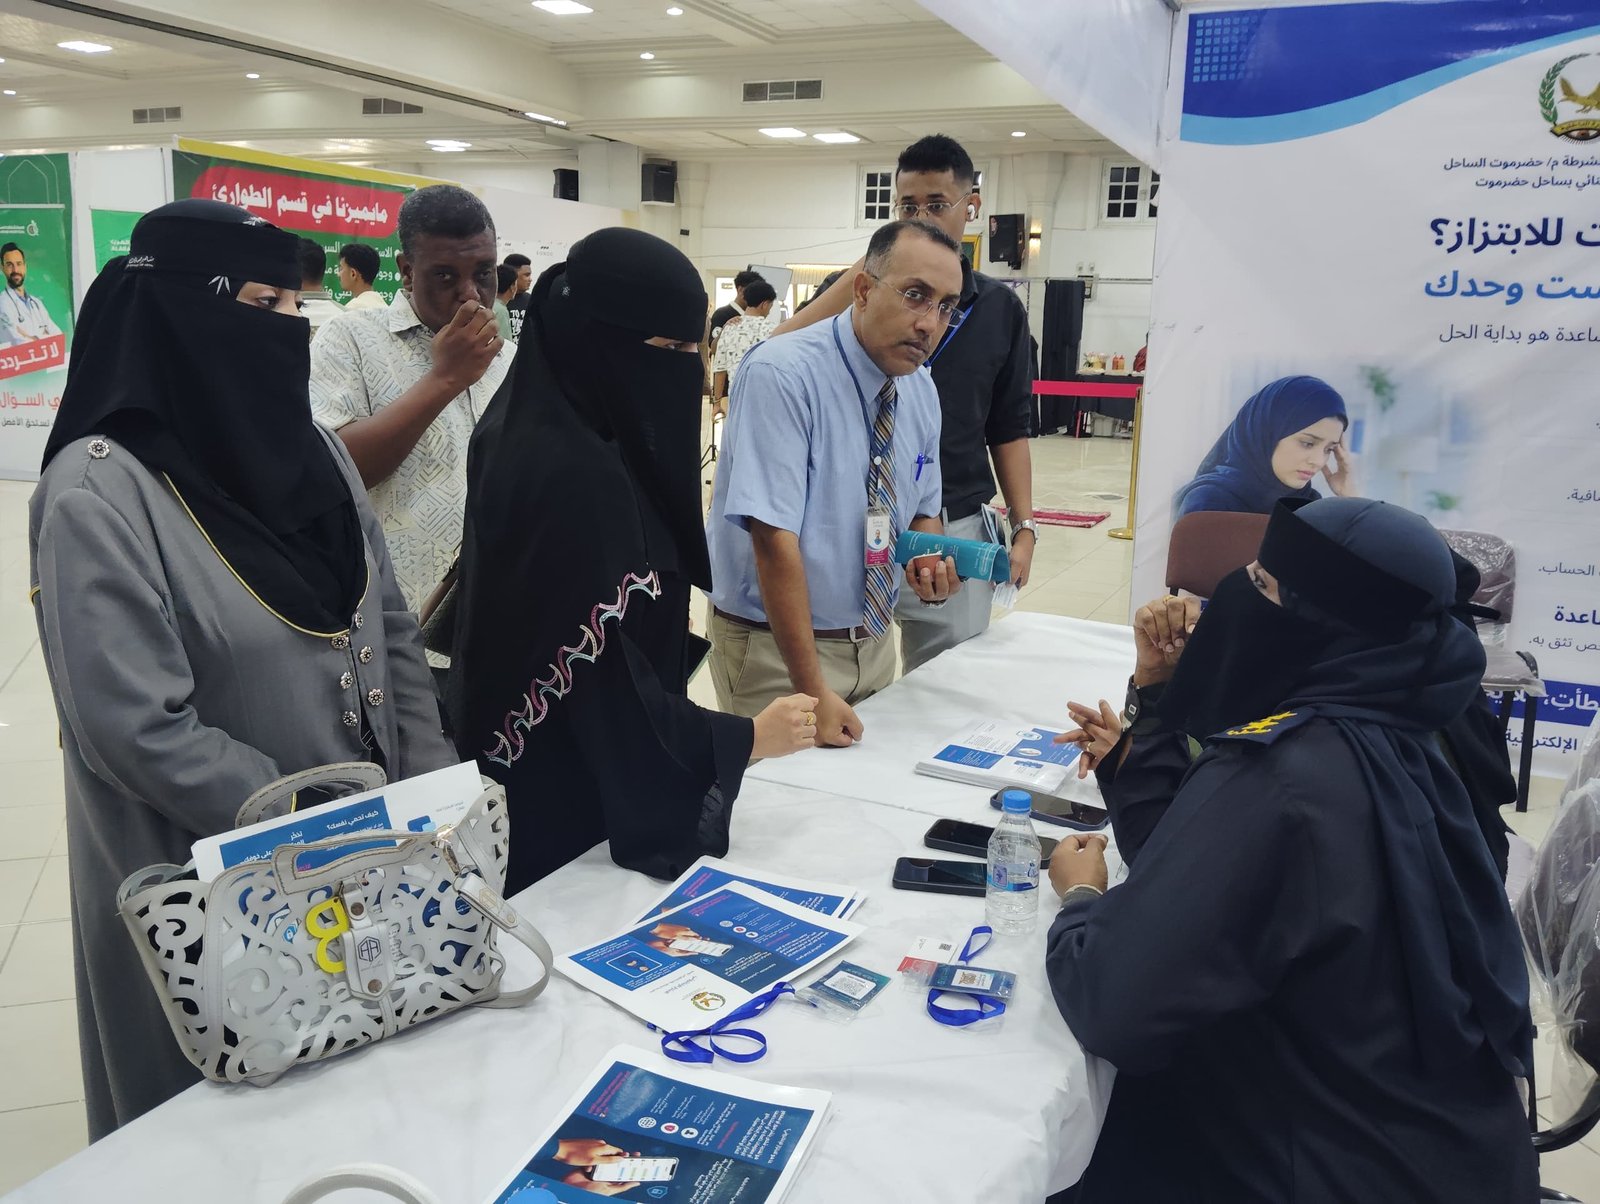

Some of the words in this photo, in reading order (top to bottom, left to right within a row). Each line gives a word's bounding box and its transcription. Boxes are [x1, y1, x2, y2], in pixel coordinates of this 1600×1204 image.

[1443, 157, 1487, 171] الساحل
[1488, 157, 1543, 171] حضرموت
[1562, 155, 1600, 168] شرطة
[1475, 176, 1529, 190] حضرموت
[1531, 175, 1572, 189] بساحل
[1575, 174, 1600, 191] نائي
[212, 182, 272, 209] الطوارئ
[277, 191, 308, 217] قسم
[311, 194, 332, 223] في
[1430, 216, 1564, 255] للابتزاز؟
[1424, 269, 1524, 306] وحدك
[1536, 276, 1600, 299] ست
[1439, 324, 1478, 344] الحل
[1483, 324, 1522, 344] بداية
[1527, 329, 1550, 345] هو
[49, 341, 60, 359] لا
[1567, 488, 1600, 503] افية.
[1538, 561, 1595, 577] الحساب.
[1554, 605, 1600, 625] اعدة
[1528, 636, 1544, 647] به.
[1548, 637, 1573, 650] تثق
[346, 813, 365, 826] تحمي
[364, 809, 379, 819] كيف
[326, 819, 347, 831] نفسك؟
